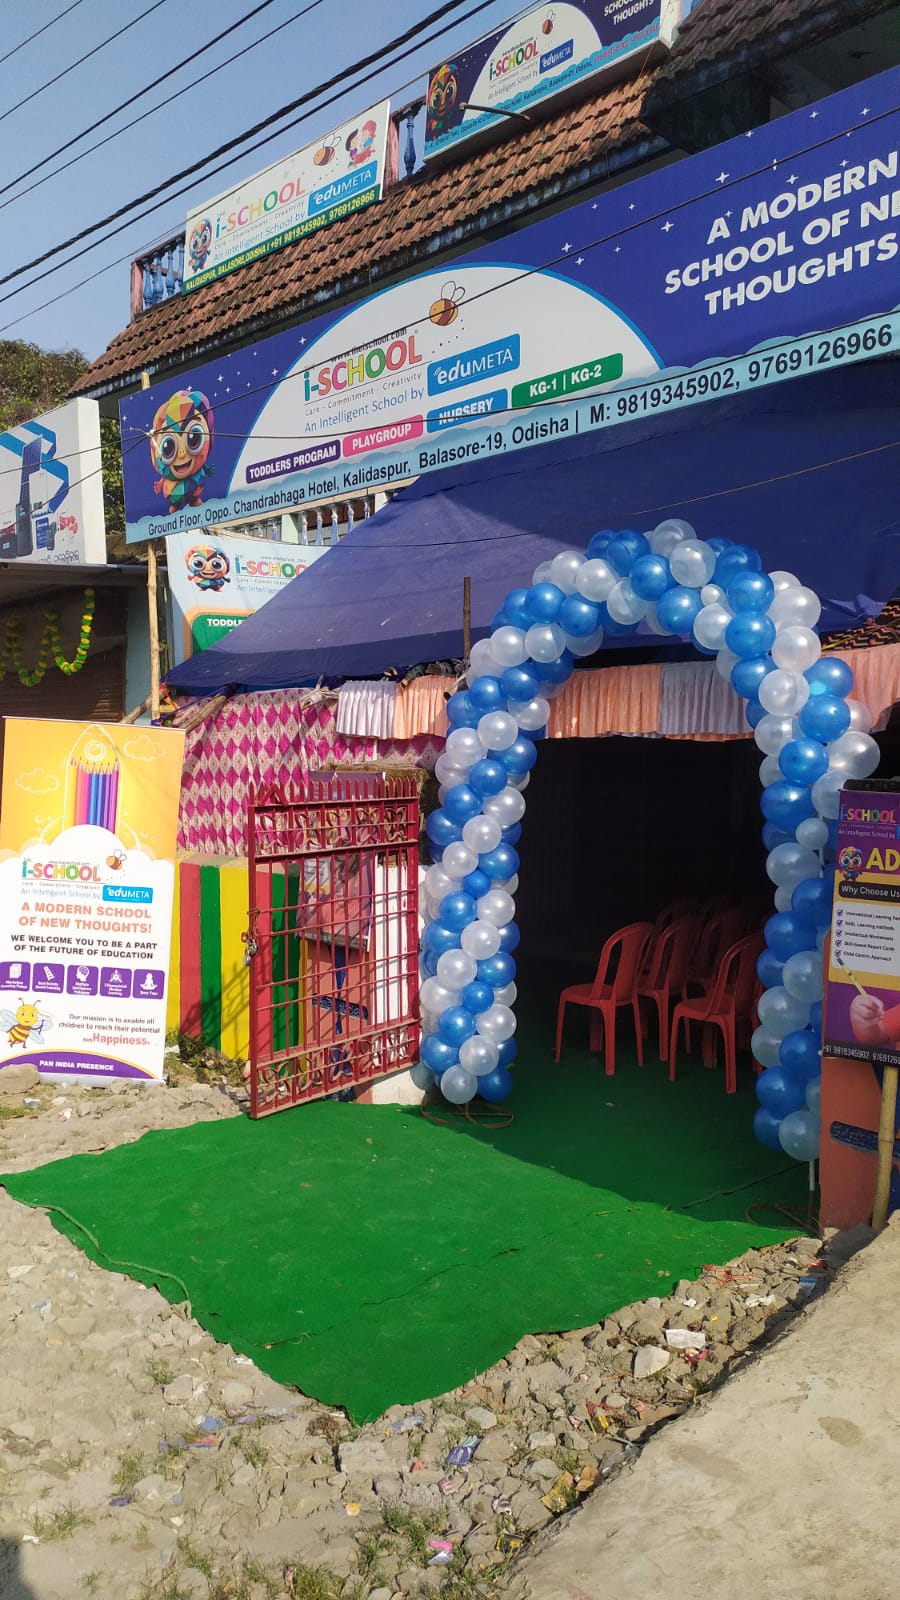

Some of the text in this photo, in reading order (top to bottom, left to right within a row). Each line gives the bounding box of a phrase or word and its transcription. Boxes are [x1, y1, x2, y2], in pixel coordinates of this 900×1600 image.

[490, 40, 539, 80] i-SCHOOL
[315, 170, 372, 205] eduMETA
[706, 150, 898, 245] A MODERN
[216, 177, 305, 238] i-SCHOOL
[270, 236, 282, 249] +91
[329, 190, 375, 221] 9769126966
[213, 211, 305, 261] An Intelligent School by
[664, 231, 794, 294] SCHOOL
[802, 208, 850, 245] OF
[705, 232, 899, 315] THOUGHTS
[304, 335, 423, 401] i-SCHOOL
[437, 348, 513, 385] eduMETA
[529, 377, 558, 399] KG-1
[571, 364, 602, 386] KG-2
[304, 372, 422, 416] Care Commitment Creativity
[304, 386, 425, 433] An Intelligent School by
[439, 397, 494, 425] NURSERY
[148, 516, 177, 536] Ground
[179, 512, 203, 529] Floor,
[204, 508, 231, 525] Oppo.
[234, 488, 305, 515] Chandrabhaga
[308, 476, 340, 498] Hotel,
[343, 460, 411, 488] Kalidaspur,
[419, 431, 507, 469] Balasore-19,
[512, 415, 569, 444] Odisha
[590, 403, 611, 424] M:
[617, 367, 740, 417] 9819345902,
[748, 324, 893, 382] 9769126966
[352, 423, 412, 450] PLAYGROUP
[250, 445, 337, 479] TODDLERS PROGRAM
[840, 806, 897, 823] i-SCHOOL
[22, 861, 101, 882] i-SCHOOL
[33, 888, 66, 897] Intelligent
[69, 890, 91, 898] School
[108, 886, 150, 899] eduMETA
[841, 885, 858, 896] Why
[860, 886, 889, 897] Choose
[19, 916, 152, 933] OF NEW THOUGHTS!
[21, 902, 152, 919] A MODERN SCHOOL
[11, 934, 25, 942] WE
[29, 935, 73, 945] WELCOME
[76, 938, 94, 946] YOU
[97, 939, 109, 947] TO
[111, 940, 123, 948] BE
[134, 942, 158, 950] PART
[29, 945, 46, 953] THE
[49, 946, 84, 955] FUTURE
[87, 948, 99, 956] OF
[101, 949, 153, 959] EDUCATION
[93, 1033, 150, 1046] Happiness.
[95, 1023, 112, 1031] reach
[131, 1025, 160, 1034] potential
[39, 1059, 55, 1067] PAN
[76, 1062, 114, 1071] PRESENCE
